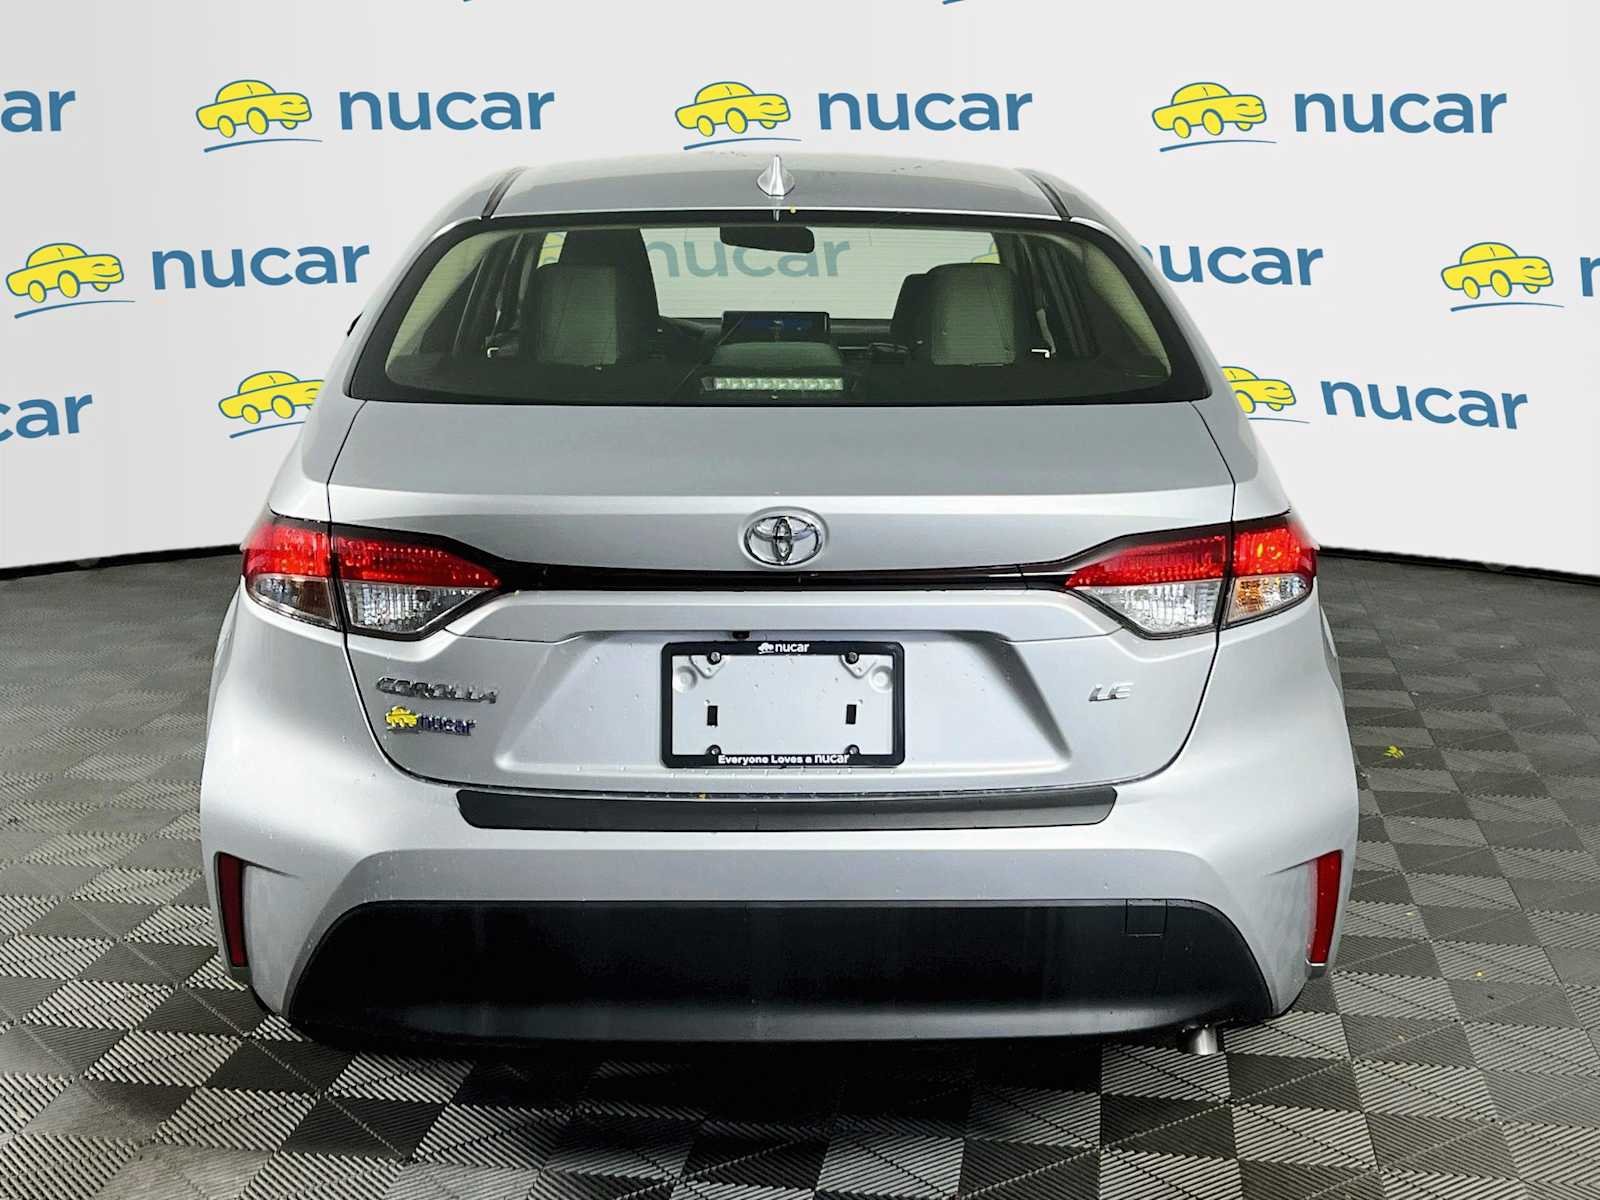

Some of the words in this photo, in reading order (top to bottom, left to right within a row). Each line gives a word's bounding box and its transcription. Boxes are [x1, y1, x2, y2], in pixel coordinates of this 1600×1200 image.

[340, 92, 556, 132] nucar
[819, 93, 1034, 133] nucar
[1295, 93, 1508, 135] nucar
[153, 245, 371, 291] nucar
[1321, 381, 1529, 431] nucar
[774, 643, 810, 652] nucar
[376, 676, 498, 704] COROLLA
[1088, 682, 1134, 702] LE
[419, 713, 477, 736] nucar
[718, 755, 768, 765] Everyone
[771, 755, 803, 764] Loves
[815, 754, 850, 764] nucar
